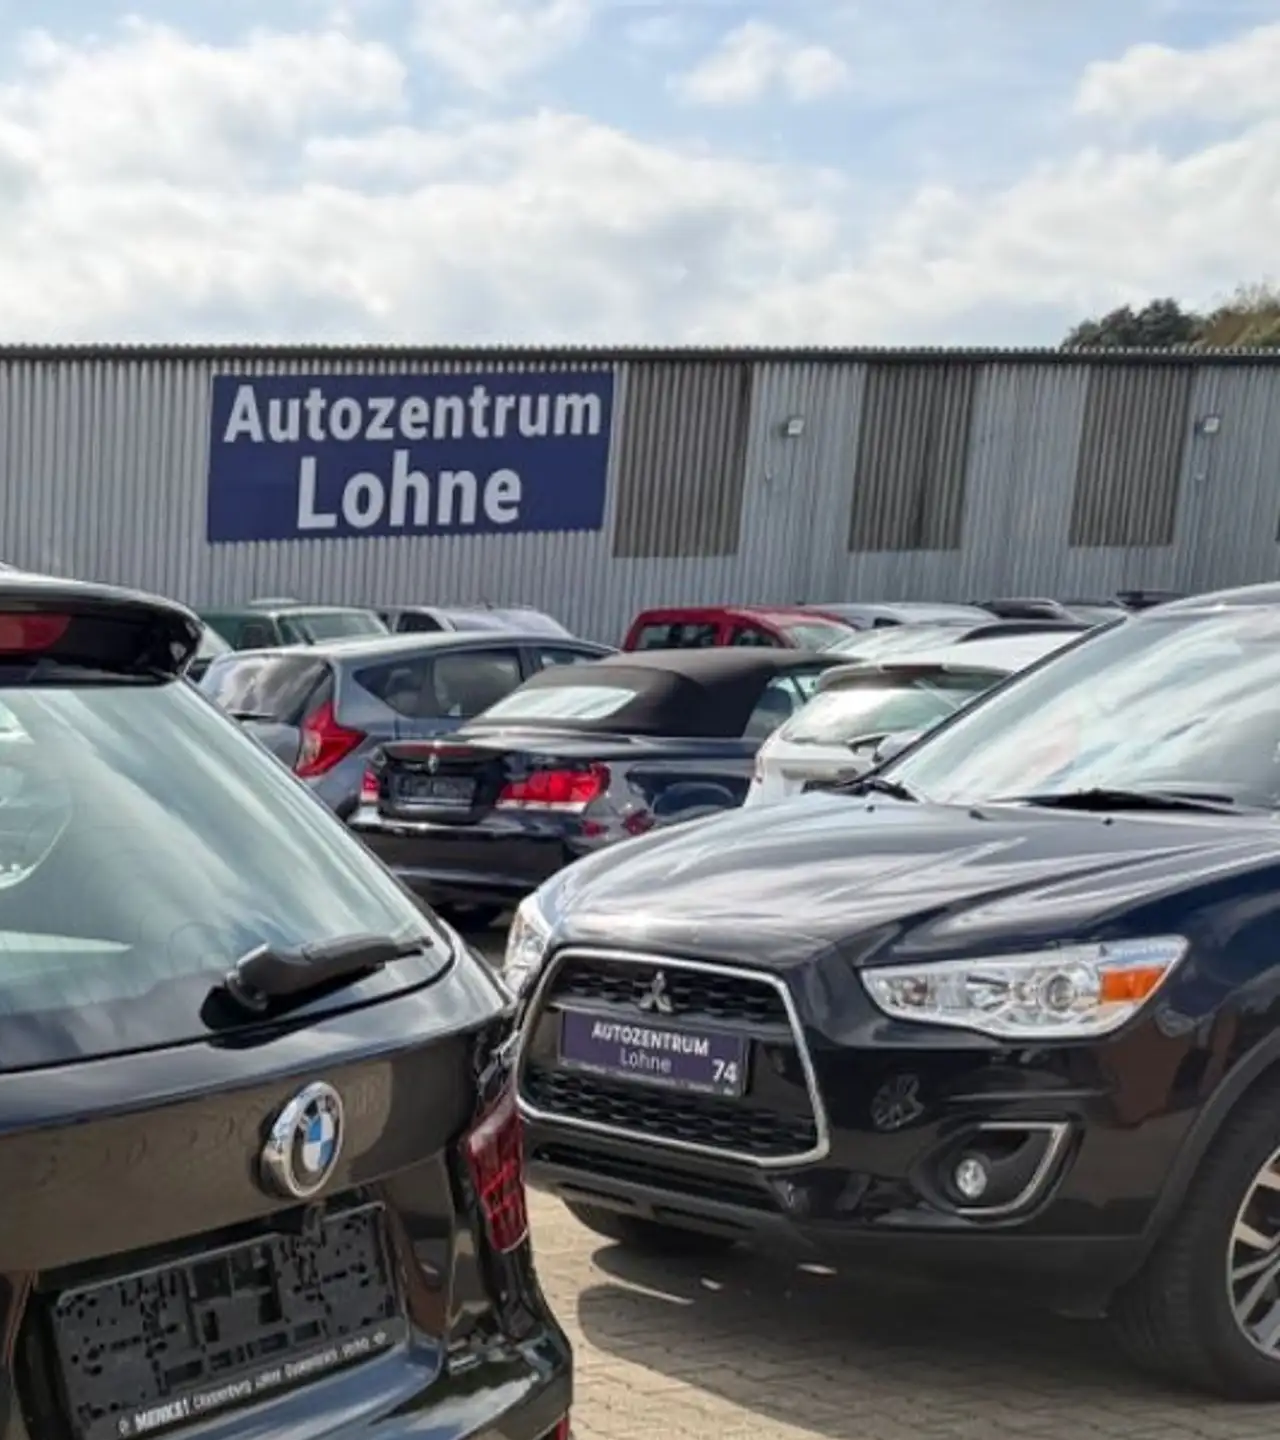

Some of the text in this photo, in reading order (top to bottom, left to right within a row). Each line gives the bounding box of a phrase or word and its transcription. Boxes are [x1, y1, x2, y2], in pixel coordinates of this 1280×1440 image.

[223, 385, 601, 442] Autozentrum
[297, 449, 523, 530] Lohne
[591, 1020, 710, 1057] AUTOZENTRUM
[619, 1047, 673, 1074] Lohne
[711, 1058, 738, 1084] 74
